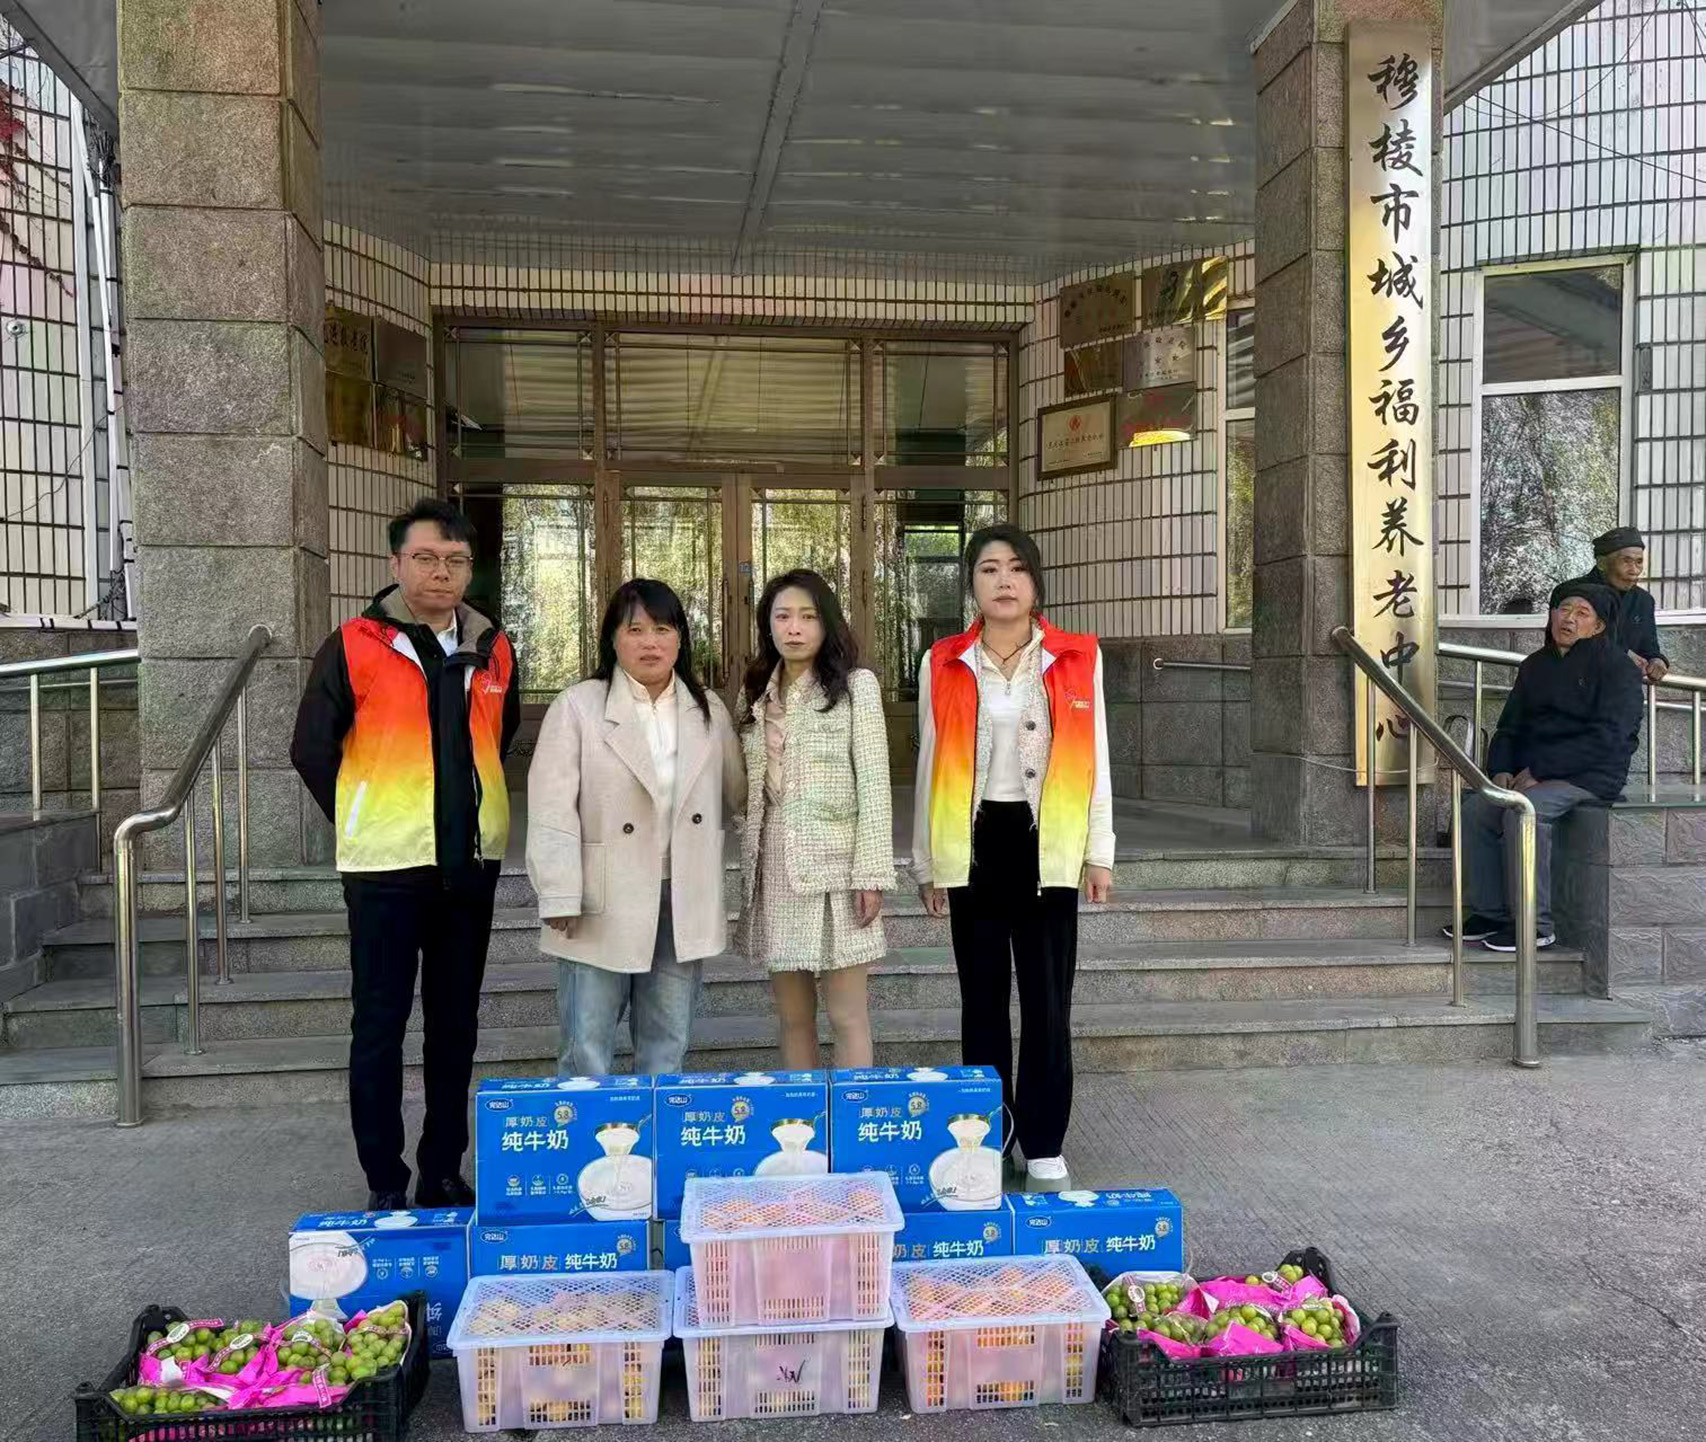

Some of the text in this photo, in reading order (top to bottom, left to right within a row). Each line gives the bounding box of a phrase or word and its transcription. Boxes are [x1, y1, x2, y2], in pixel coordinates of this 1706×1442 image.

[1368, 52, 1424, 741] 穆棱市城乡福利养老中心
[684, 1111, 726, 1122] 厚奶皮
[861, 1107, 901, 1118] 厚奶皮
[505, 1116, 548, 1128] 厚奶皮
[502, 1129, 569, 1151] 纯牛奶
[681, 1124, 746, 1147] 纯牛奶
[858, 1120, 922, 1143] 纯牛奶
[893, 1240, 984, 1258] 奶皮 纯牛奶
[1045, 1235, 1156, 1254] 厚奶皮 纯牛奶
[500, 1253, 618, 1270] 厚奶皮 纯牛奶
